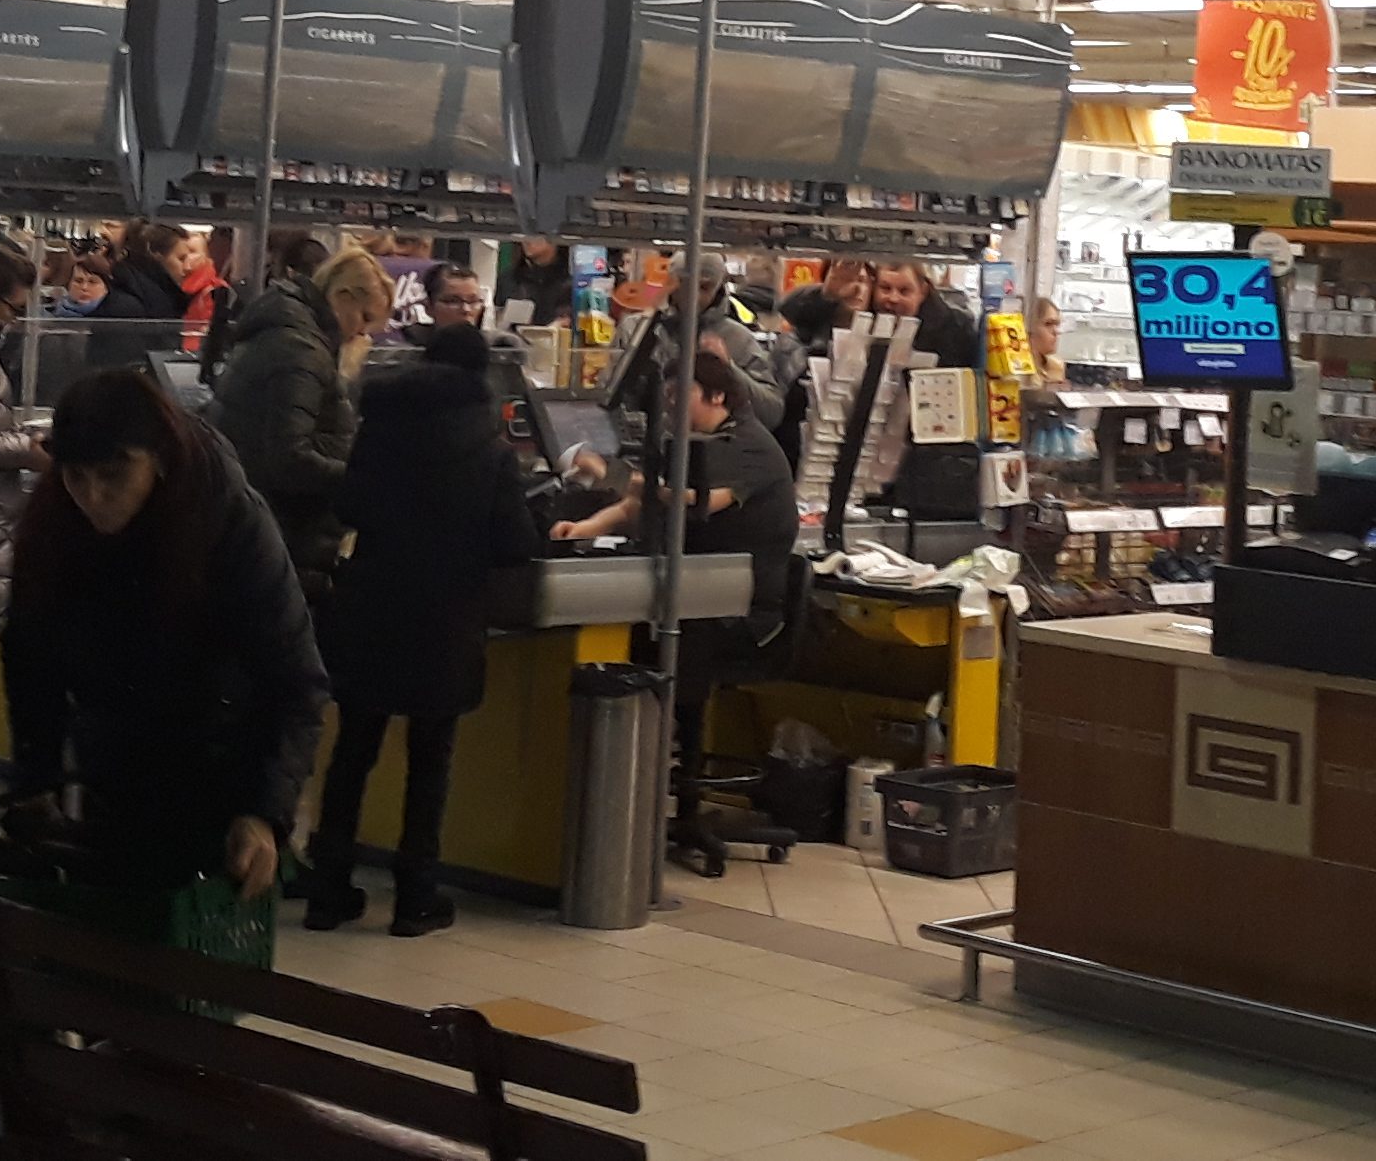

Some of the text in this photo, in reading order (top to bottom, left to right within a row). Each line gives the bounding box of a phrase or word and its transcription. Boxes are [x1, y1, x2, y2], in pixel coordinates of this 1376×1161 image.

[1179, 148, 1323, 173] BANKOMATAS
[1133, 264, 1276, 310] 30,4
[1144, 314, 1274, 340] milijono
